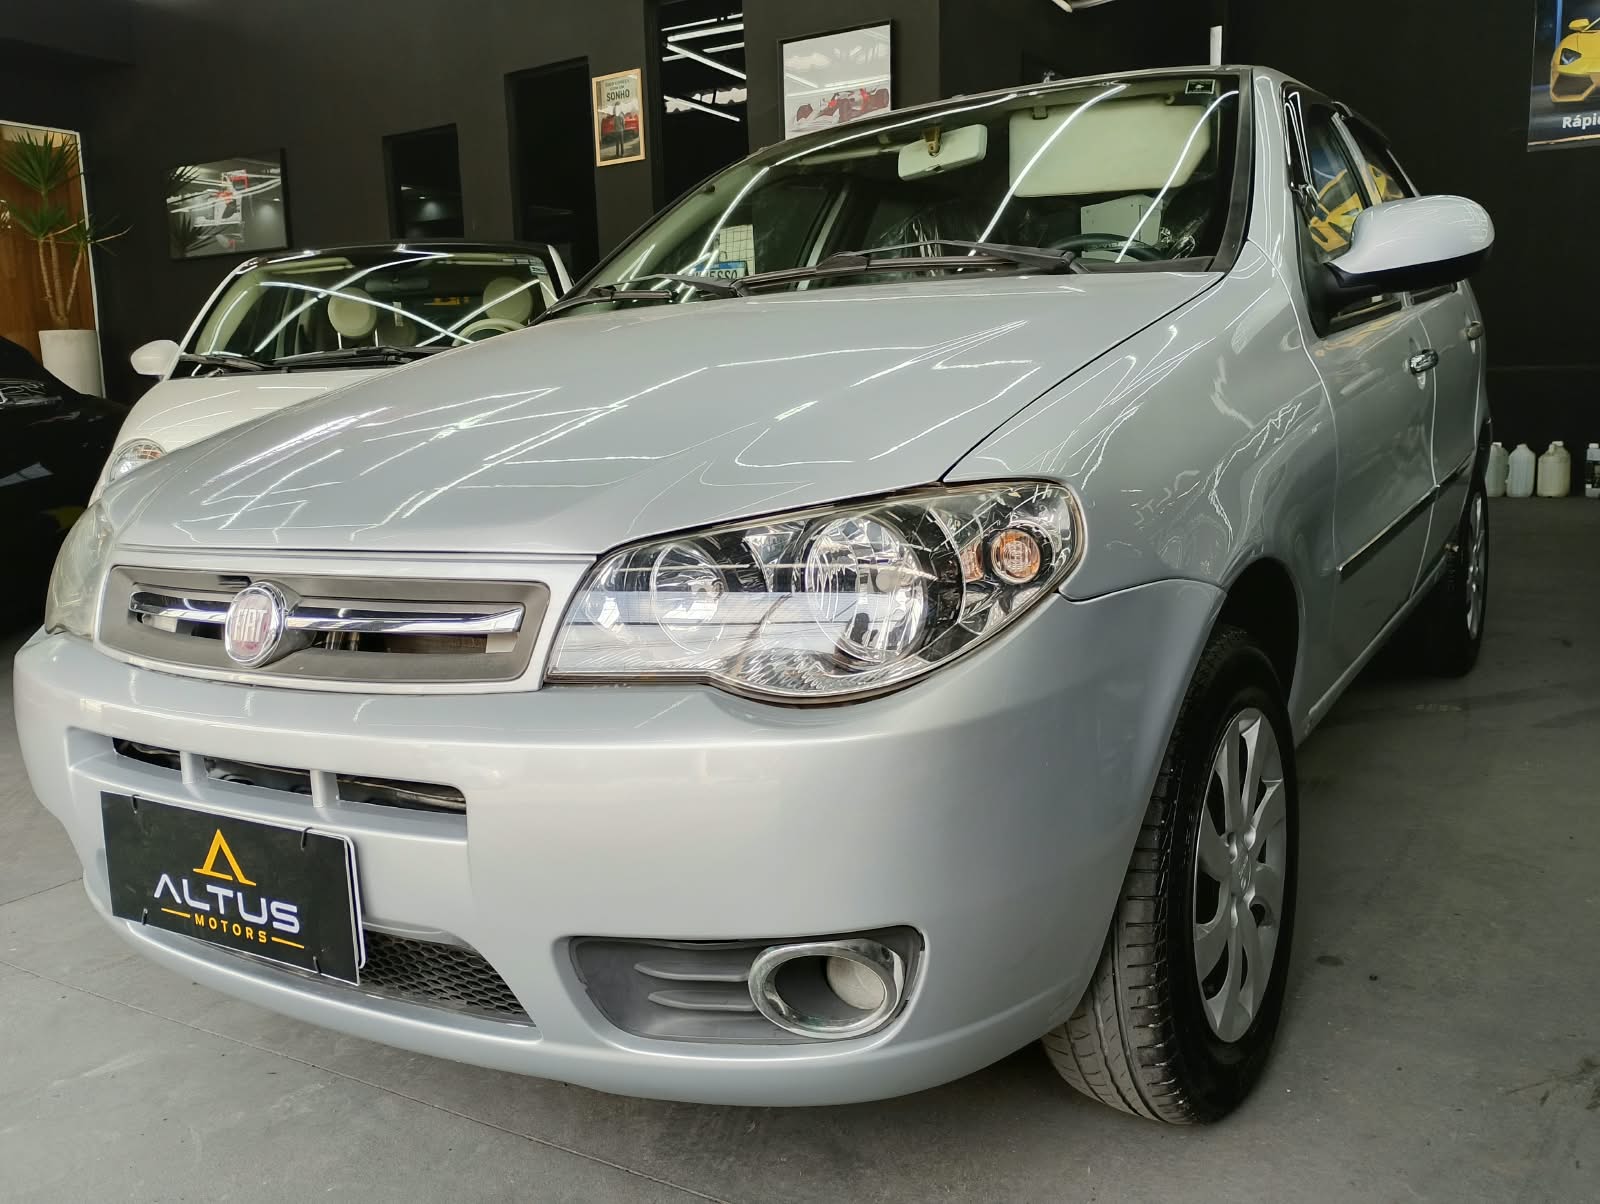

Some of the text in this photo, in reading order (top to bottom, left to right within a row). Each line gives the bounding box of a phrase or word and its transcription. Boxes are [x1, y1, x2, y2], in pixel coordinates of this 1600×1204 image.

[606, 89, 630, 102] SONHO
[233, 608, 268, 642] FIAT
[153, 873, 300, 934] ALTUS
[194, 913, 267, 944] MOTORS
